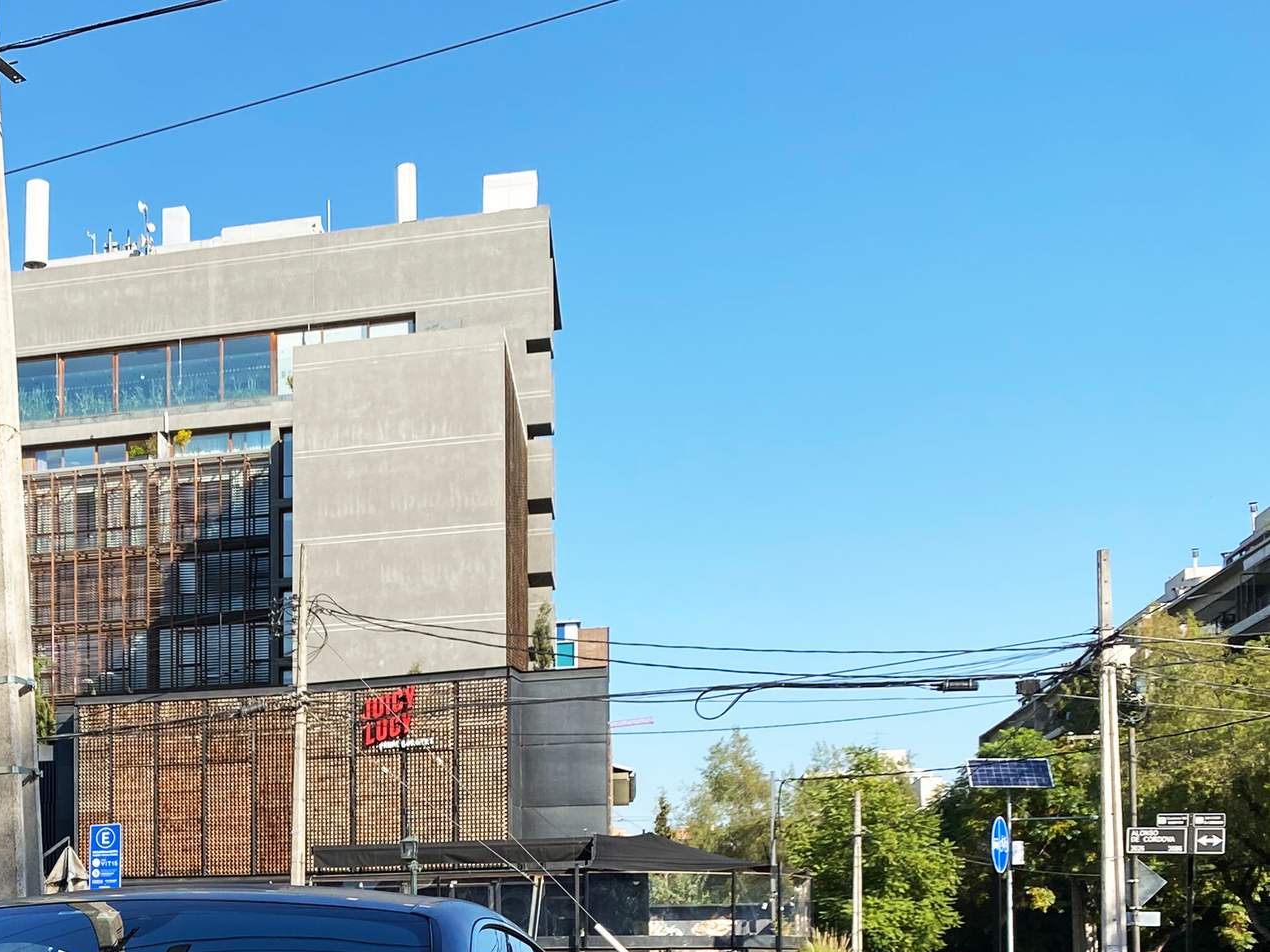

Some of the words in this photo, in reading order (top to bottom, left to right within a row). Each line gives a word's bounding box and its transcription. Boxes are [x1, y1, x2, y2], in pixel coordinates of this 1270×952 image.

[362, 685, 416, 720] JUICY
[364, 713, 412, 746] LUCY
[101, 831, 110, 845] E
